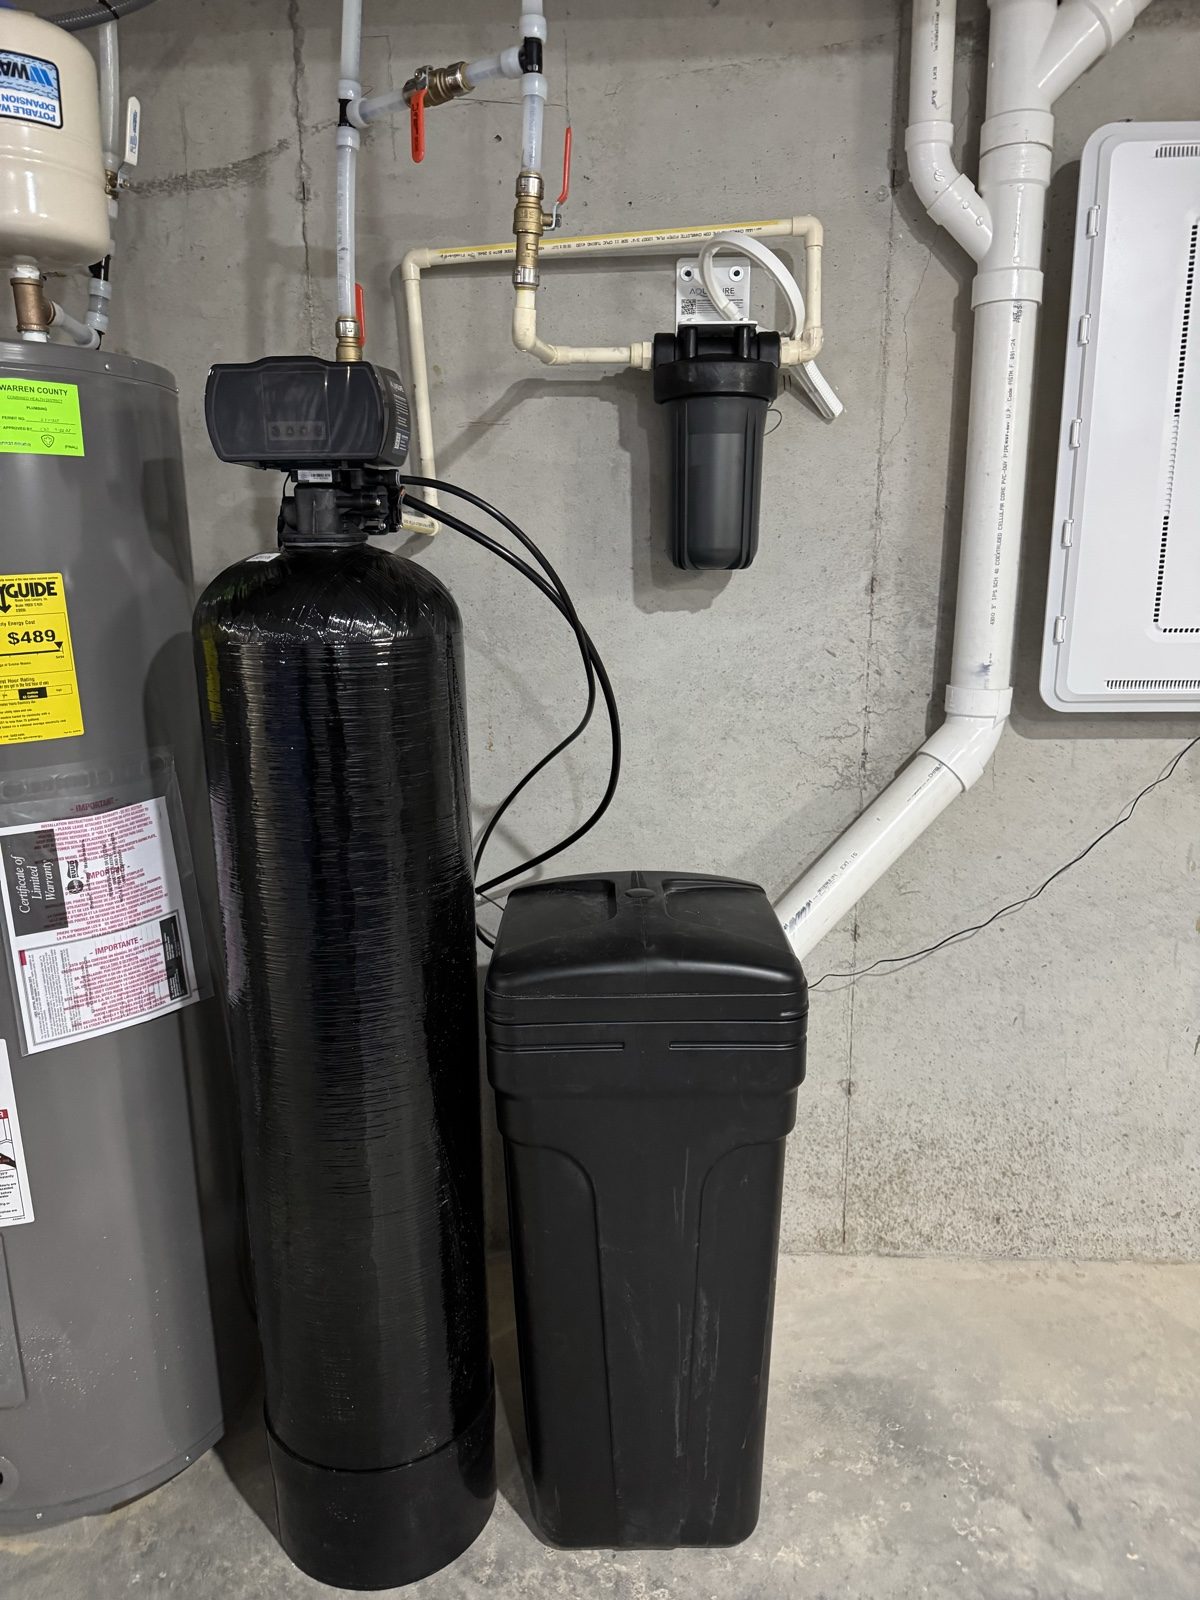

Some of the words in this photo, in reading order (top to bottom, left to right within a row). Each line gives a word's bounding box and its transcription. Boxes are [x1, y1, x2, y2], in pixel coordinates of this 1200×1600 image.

[1, 94, 56, 112] EXPANSION
[13, 105, 56, 122] POTABLE
[0, 384, 35, 393] WARREN
[37, 387, 68, 396] COUNTY
[7, 629, 56, 646] $489
[75, 797, 114, 813] IMPORTANT
[10, 854, 25, 865] of
[69, 860, 78, 878] RUUD
[27, 866, 42, 900] Limited
[43, 860, 56, 900] Warranty
[16, 867, 31, 914] Certificate
[95, 937, 139, 955] IMPORTANTE
